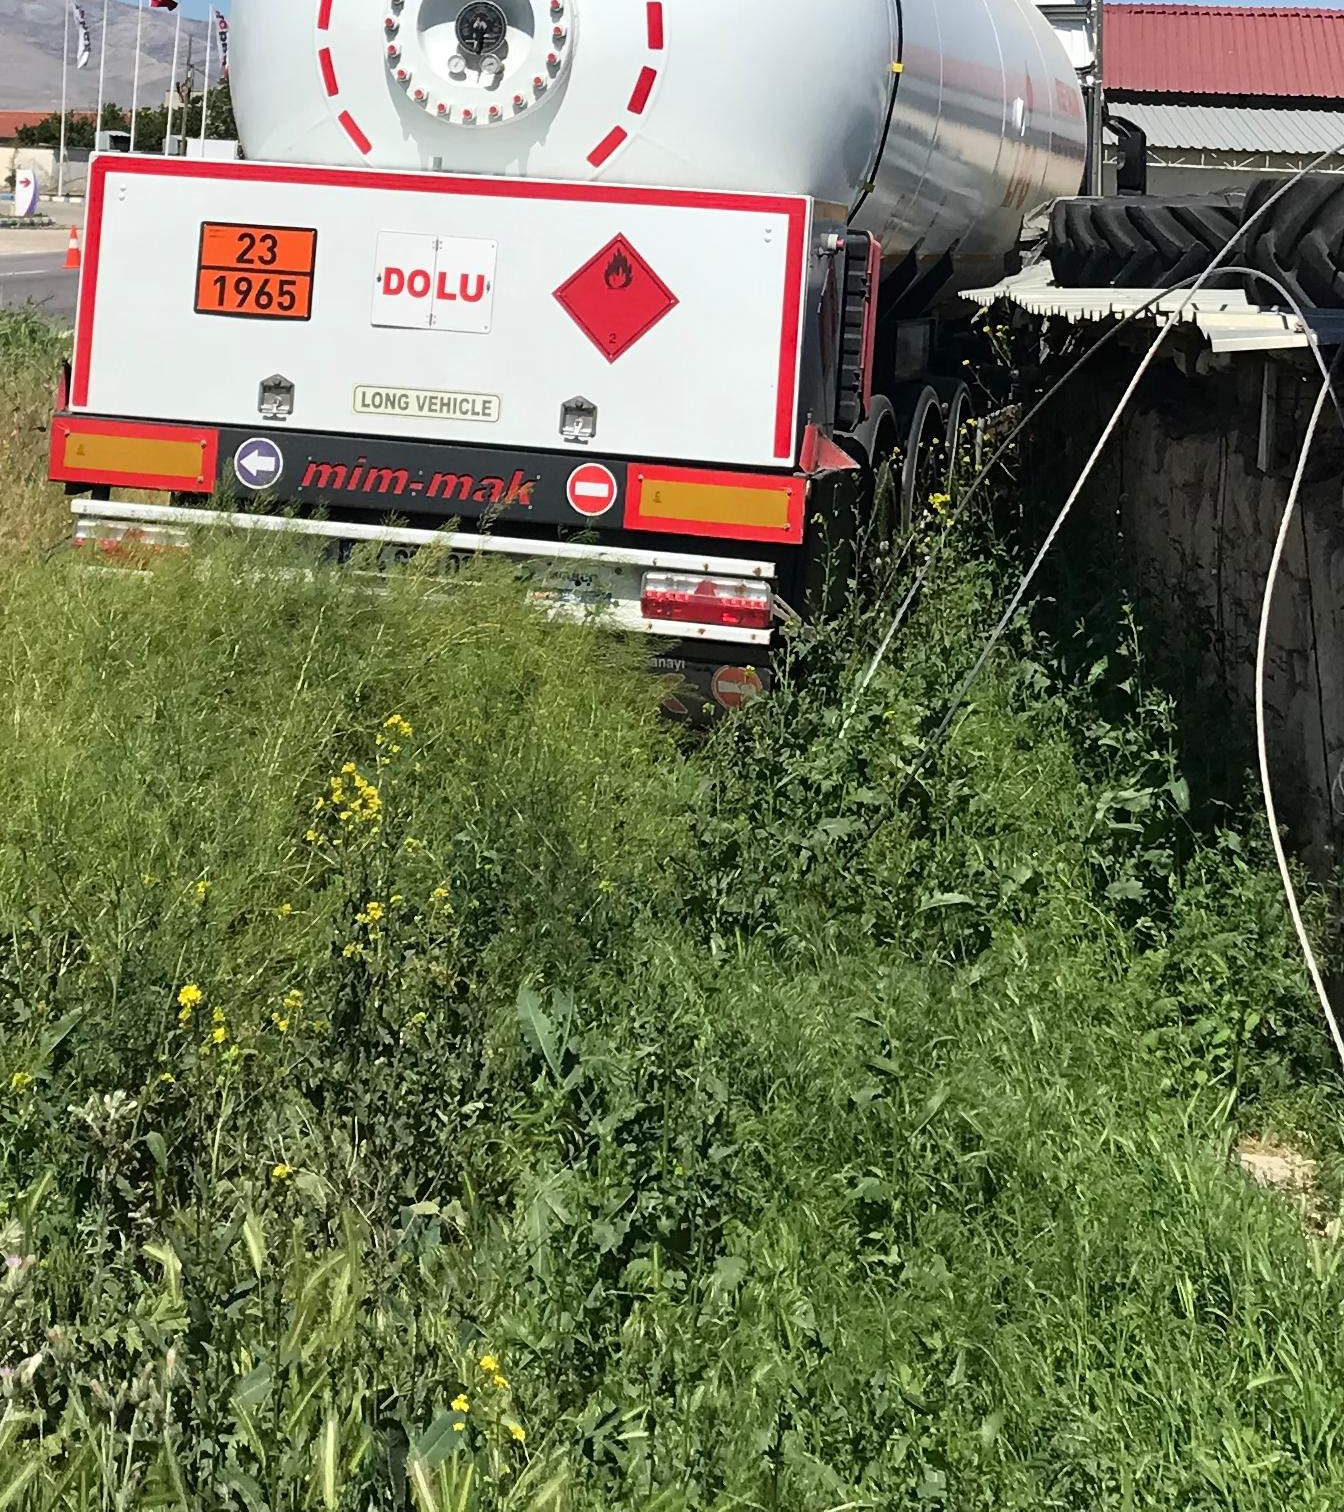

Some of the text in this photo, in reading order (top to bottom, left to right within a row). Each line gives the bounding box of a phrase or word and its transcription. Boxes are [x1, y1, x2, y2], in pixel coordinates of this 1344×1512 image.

[236, 232, 278, 265] 23
[213, 275, 296, 311] 1965
[382, 267, 485, 302] DOLU
[609, 333, 617, 344] 2
[361, 391, 492, 417] LONG VEHICLE
[301, 457, 536, 505] mim-mak
